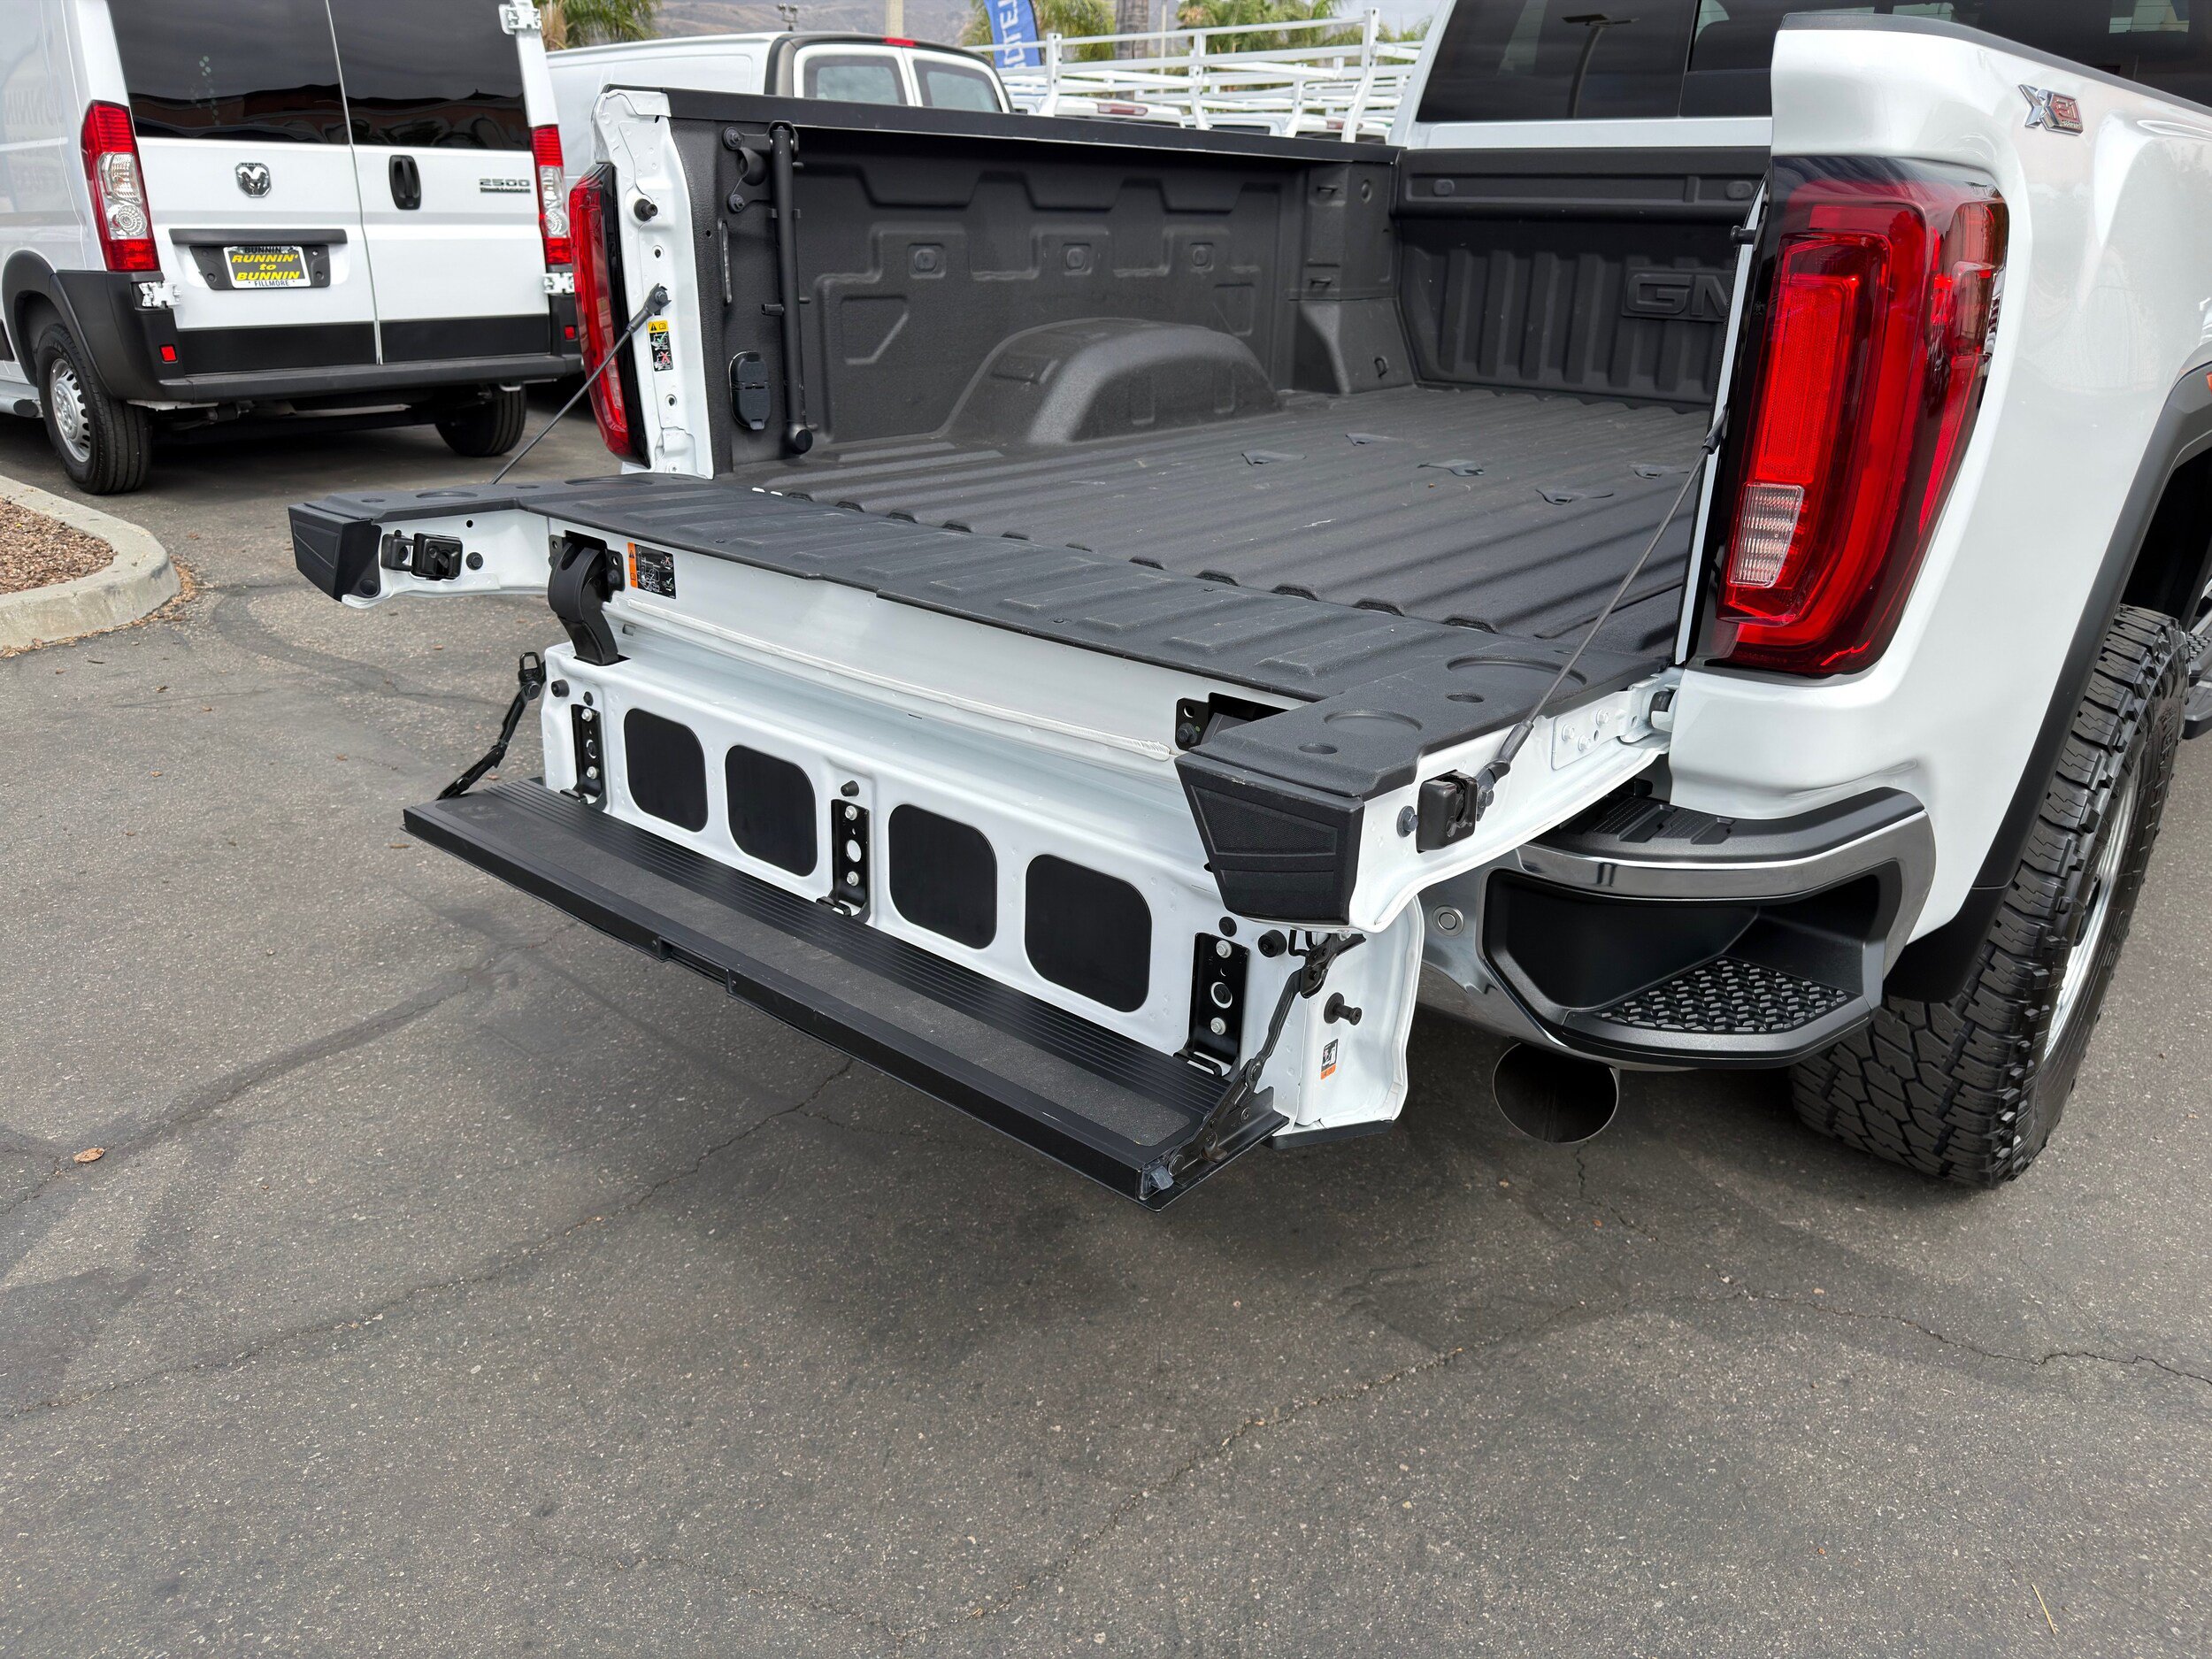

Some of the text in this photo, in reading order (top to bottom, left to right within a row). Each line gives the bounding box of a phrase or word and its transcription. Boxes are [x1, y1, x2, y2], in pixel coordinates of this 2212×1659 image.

[479, 178, 530, 187] 2500
[232, 254, 298, 263] RUNNIN'
[235, 271, 300, 280] BUNNIN
[1627, 273, 1733, 317] GM
